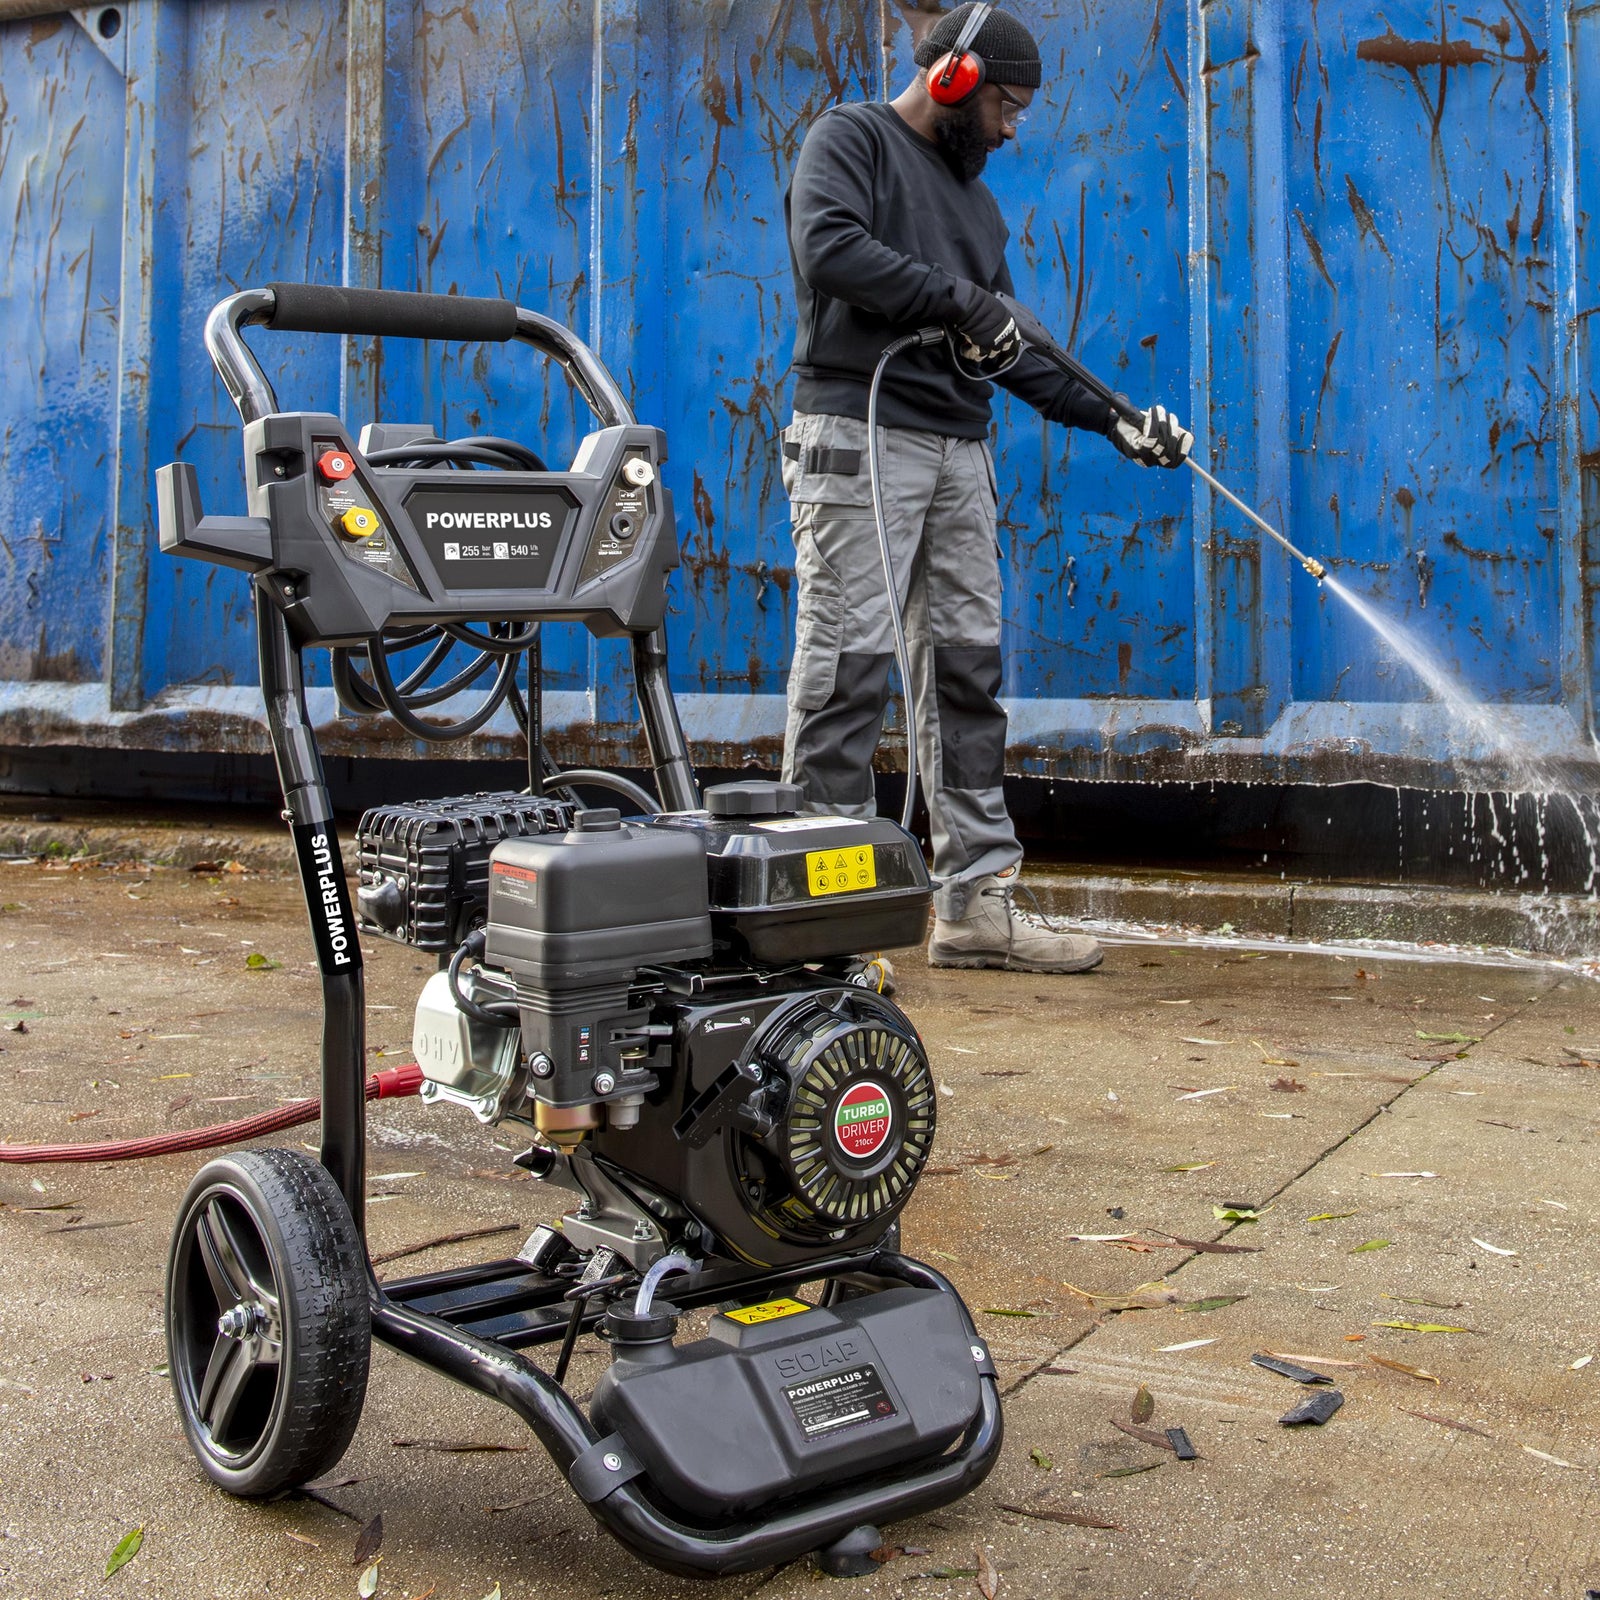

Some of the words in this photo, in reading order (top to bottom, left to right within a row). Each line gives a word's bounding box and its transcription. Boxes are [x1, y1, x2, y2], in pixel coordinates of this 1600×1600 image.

[426, 512, 552, 528] POWERPLUS
[462, 545, 480, 556] 255
[510, 545, 528, 556] 540
[311, 833, 351, 966] POWERPLUS
[418, 1032, 459, 1065] OHV
[843, 1102, 885, 1120] TURBO
[842, 1119, 885, 1138] DRIVER
[854, 1138, 874, 1147] 210cc
[775, 1341, 859, 1379] SOAP
[787, 1371, 862, 1399] POWERPLUS
